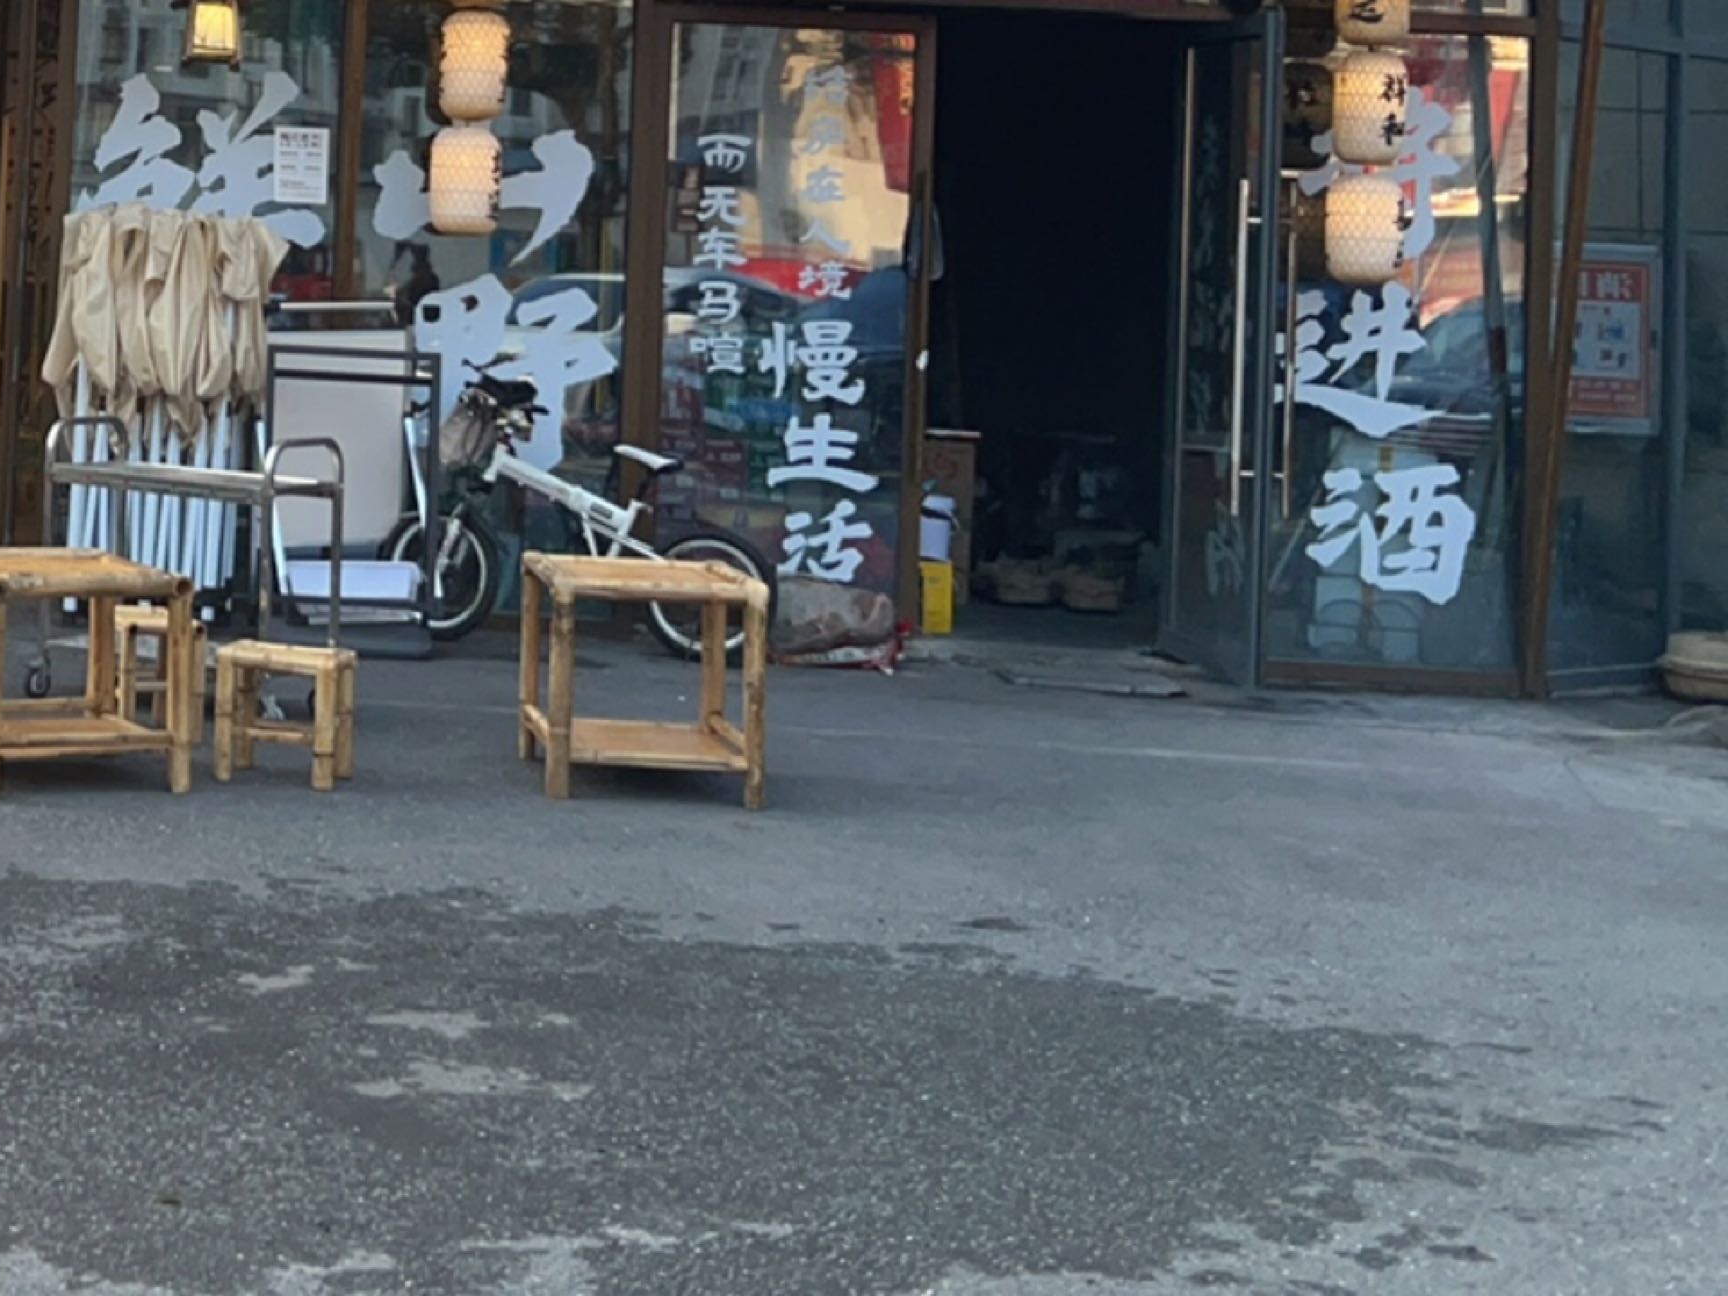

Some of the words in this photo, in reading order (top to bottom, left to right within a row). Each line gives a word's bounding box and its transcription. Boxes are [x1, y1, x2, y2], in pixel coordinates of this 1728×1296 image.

[690, 132, 752, 375] 而无车马喧
[757, 320, 880, 584] 慢生活
